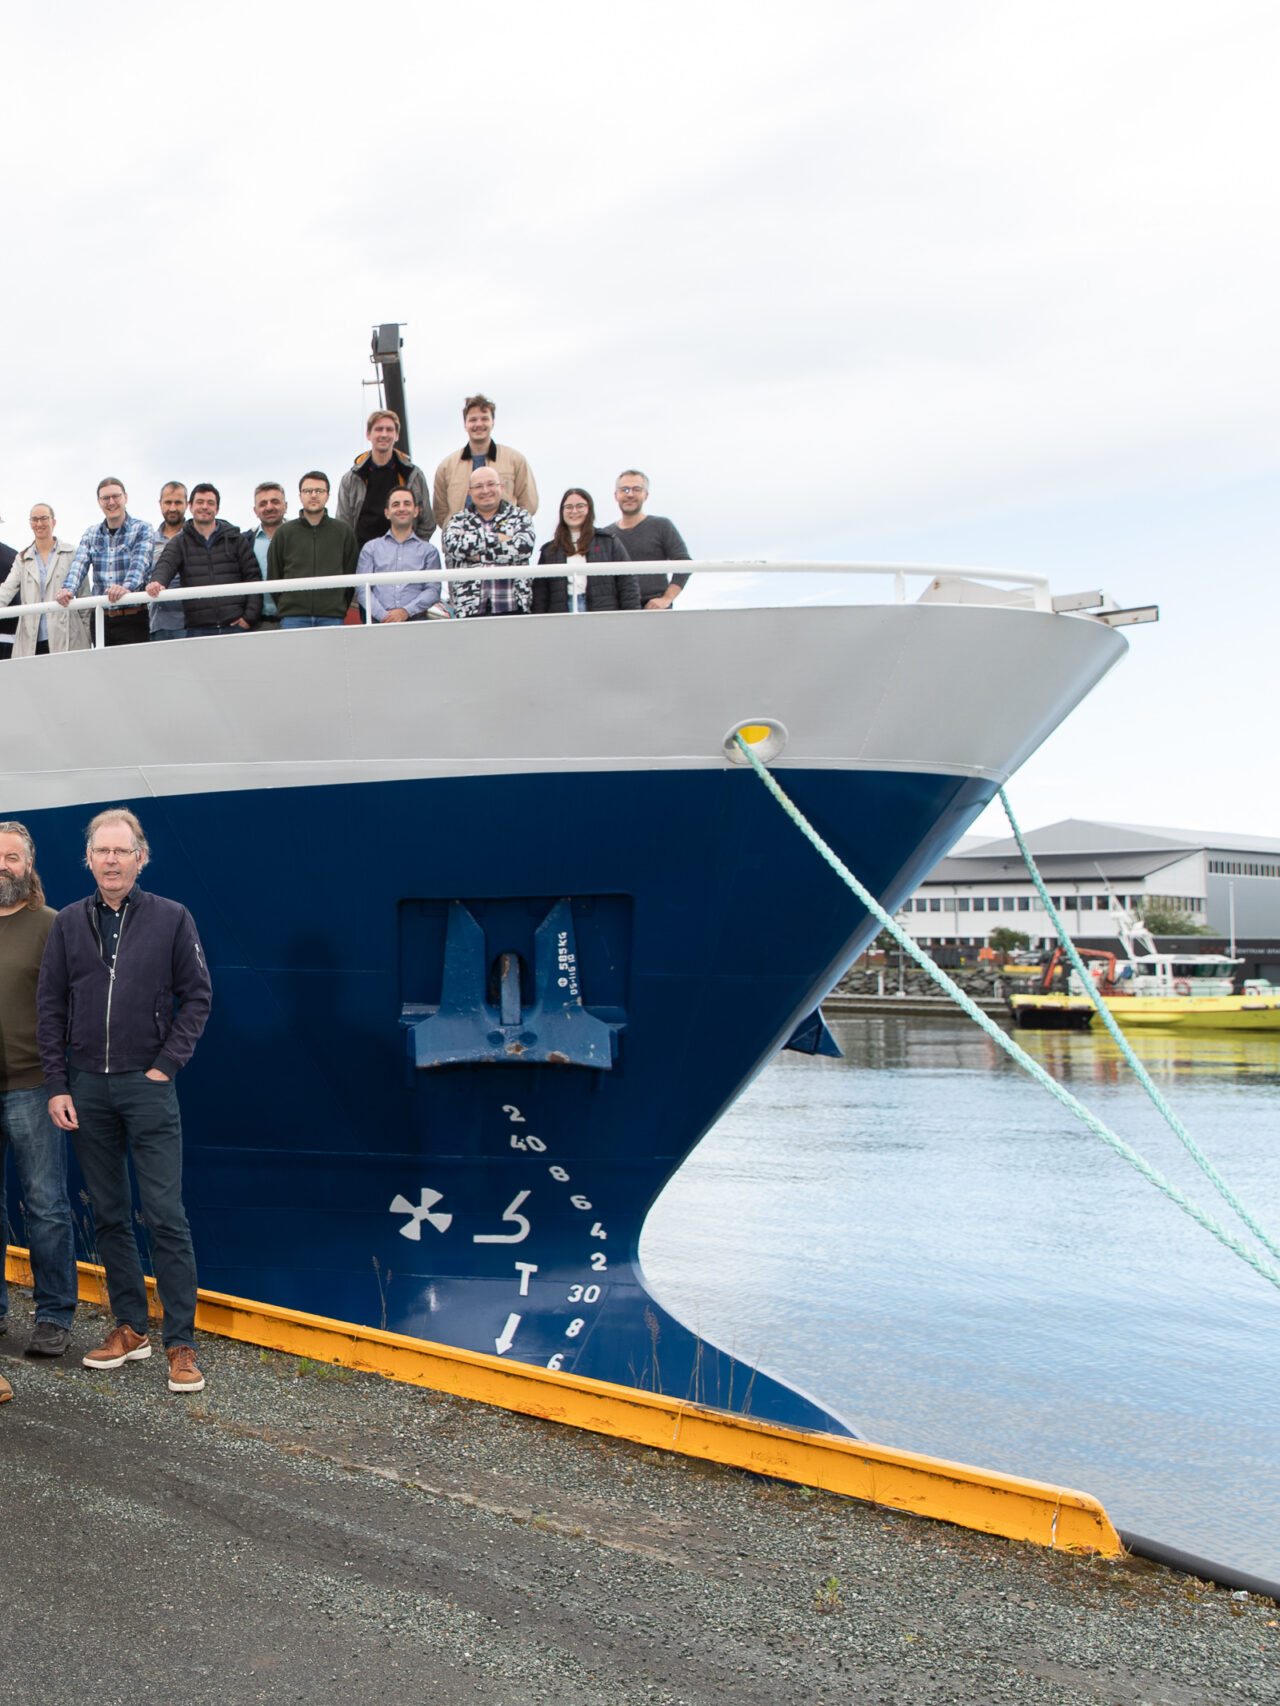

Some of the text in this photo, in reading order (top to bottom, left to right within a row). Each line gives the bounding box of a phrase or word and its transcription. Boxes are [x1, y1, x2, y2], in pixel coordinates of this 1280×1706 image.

[502, 1104, 526, 1122] 2
[510, 1134, 547, 1152] 40
[548, 1165, 570, 1182] 8
[570, 1194, 592, 1210] 6
[590, 1222, 607, 1240] 4
[590, 1252, 607, 1271] 2
[515, 1261, 538, 1296] T
[567, 1284, 601, 1303] 30
[565, 1318, 585, 1337] 8
[546, 1353, 564, 1371] 6
